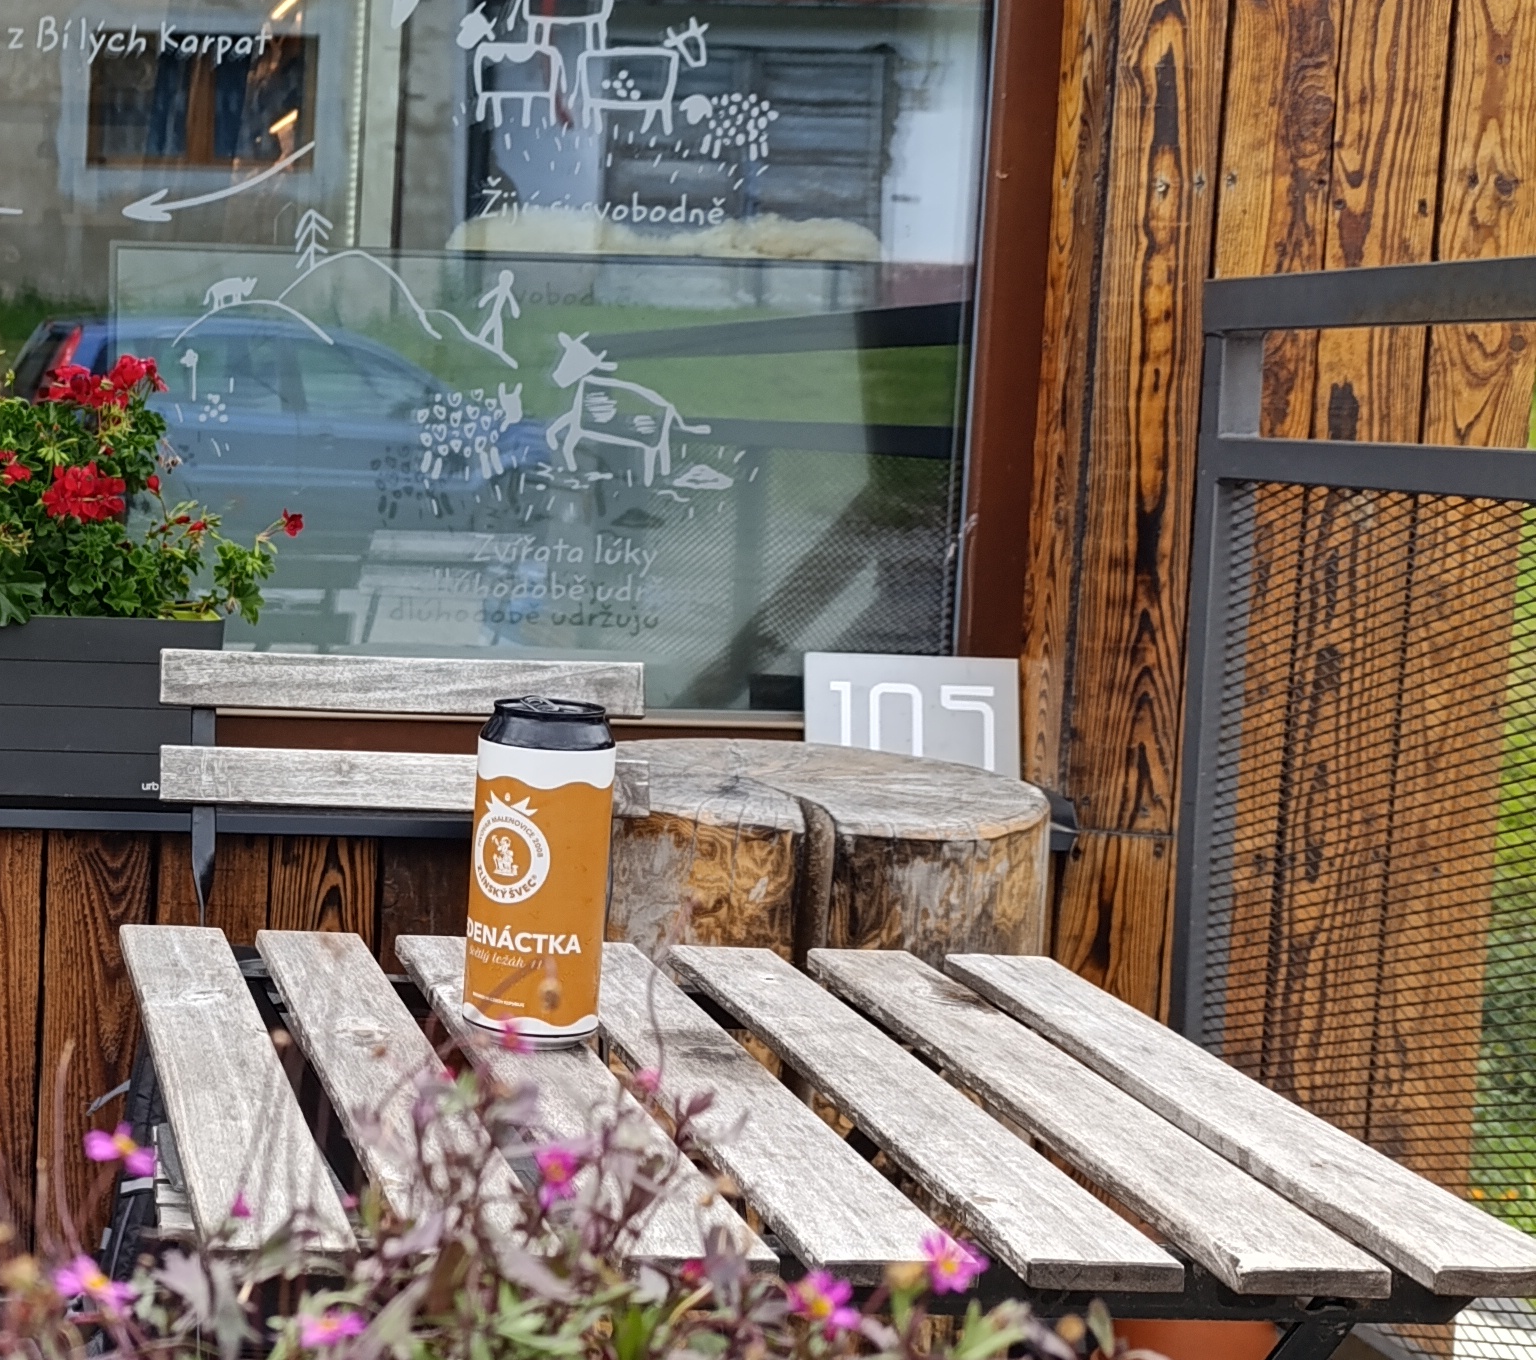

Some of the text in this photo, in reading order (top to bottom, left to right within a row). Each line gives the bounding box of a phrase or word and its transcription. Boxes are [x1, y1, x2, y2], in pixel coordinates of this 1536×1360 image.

[160, 21, 274, 64] Karpat
[473, 532, 659, 578] Zvířata lúky
[830, 681, 995, 772] 105
